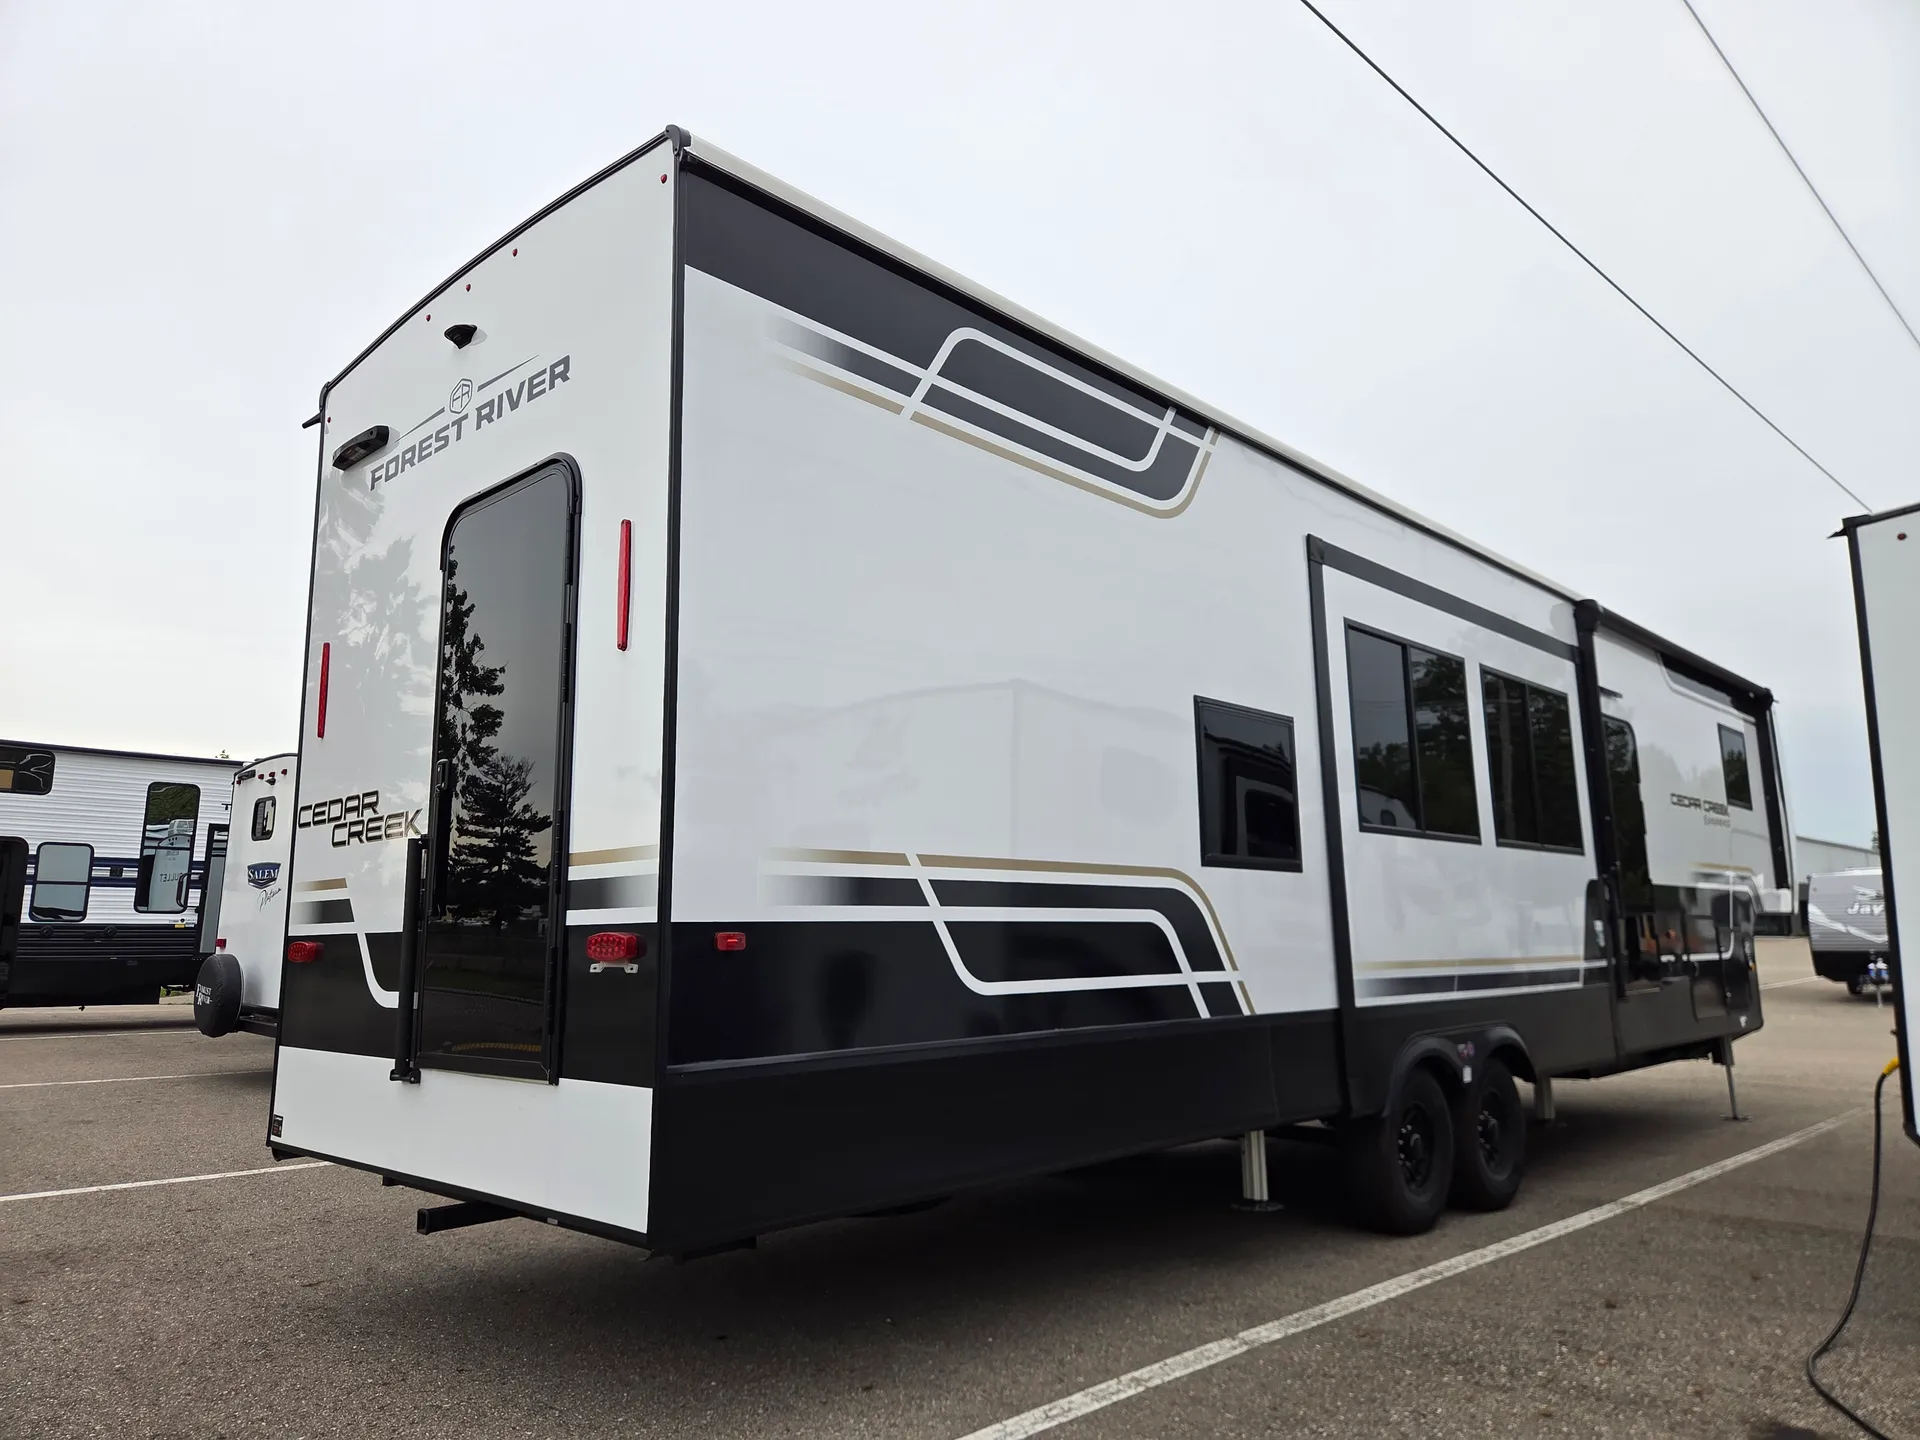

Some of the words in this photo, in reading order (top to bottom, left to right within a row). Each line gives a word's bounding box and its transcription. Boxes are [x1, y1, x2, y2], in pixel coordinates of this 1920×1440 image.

[370, 413, 469, 491] FOREST
[475, 354, 570, 431] RIVER
[298, 790, 379, 829] CEDAR
[332, 808, 423, 848] CREEK
[248, 868, 279, 880] SALEM
